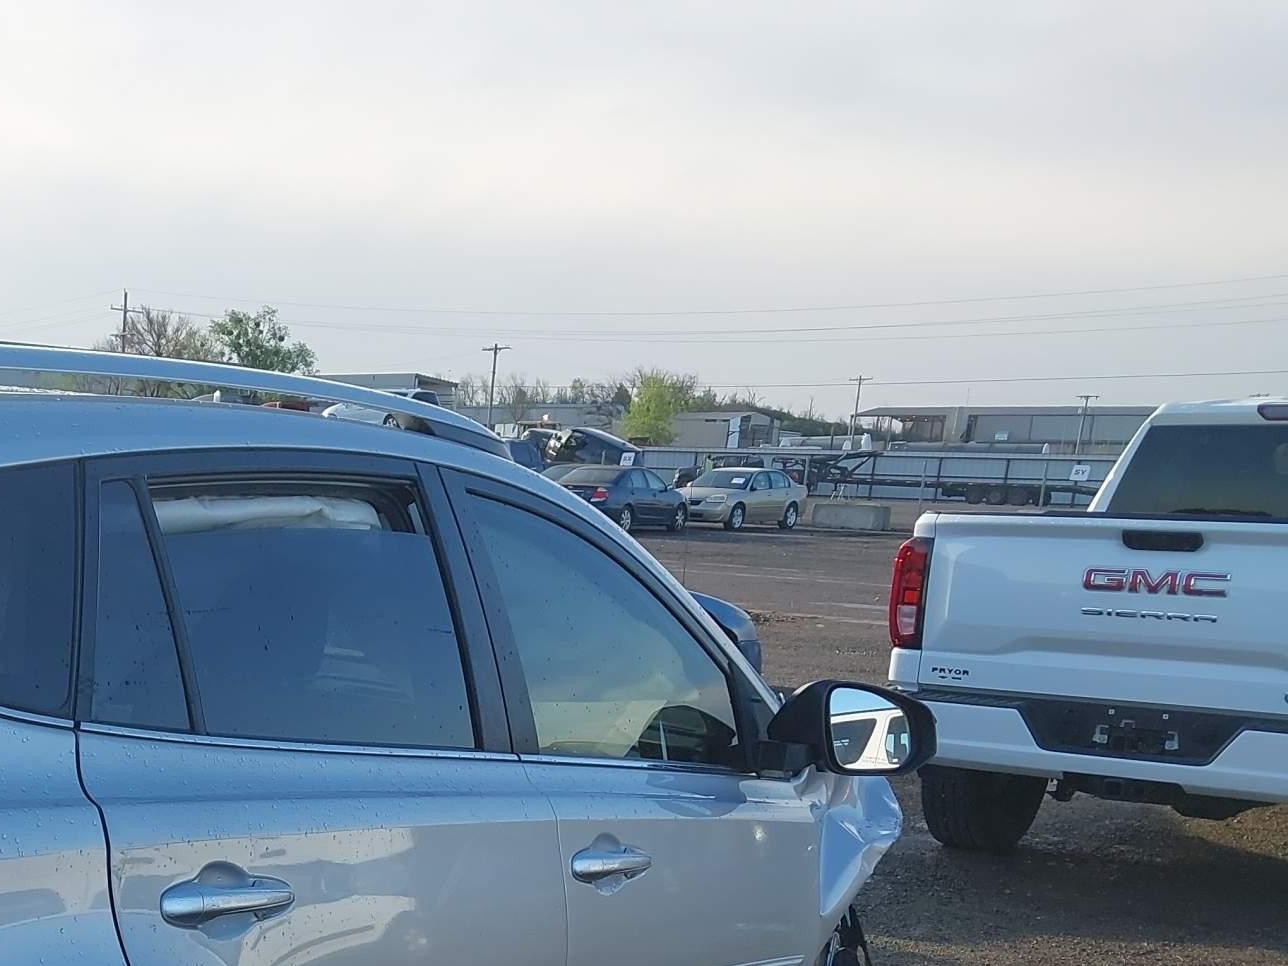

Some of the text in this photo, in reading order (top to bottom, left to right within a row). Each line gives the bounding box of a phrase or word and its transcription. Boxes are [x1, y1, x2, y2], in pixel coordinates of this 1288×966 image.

[1073, 468, 1088, 476] SY
[1082, 566, 1232, 598] GMC
[1080, 606, 1218, 623] SIERRA
